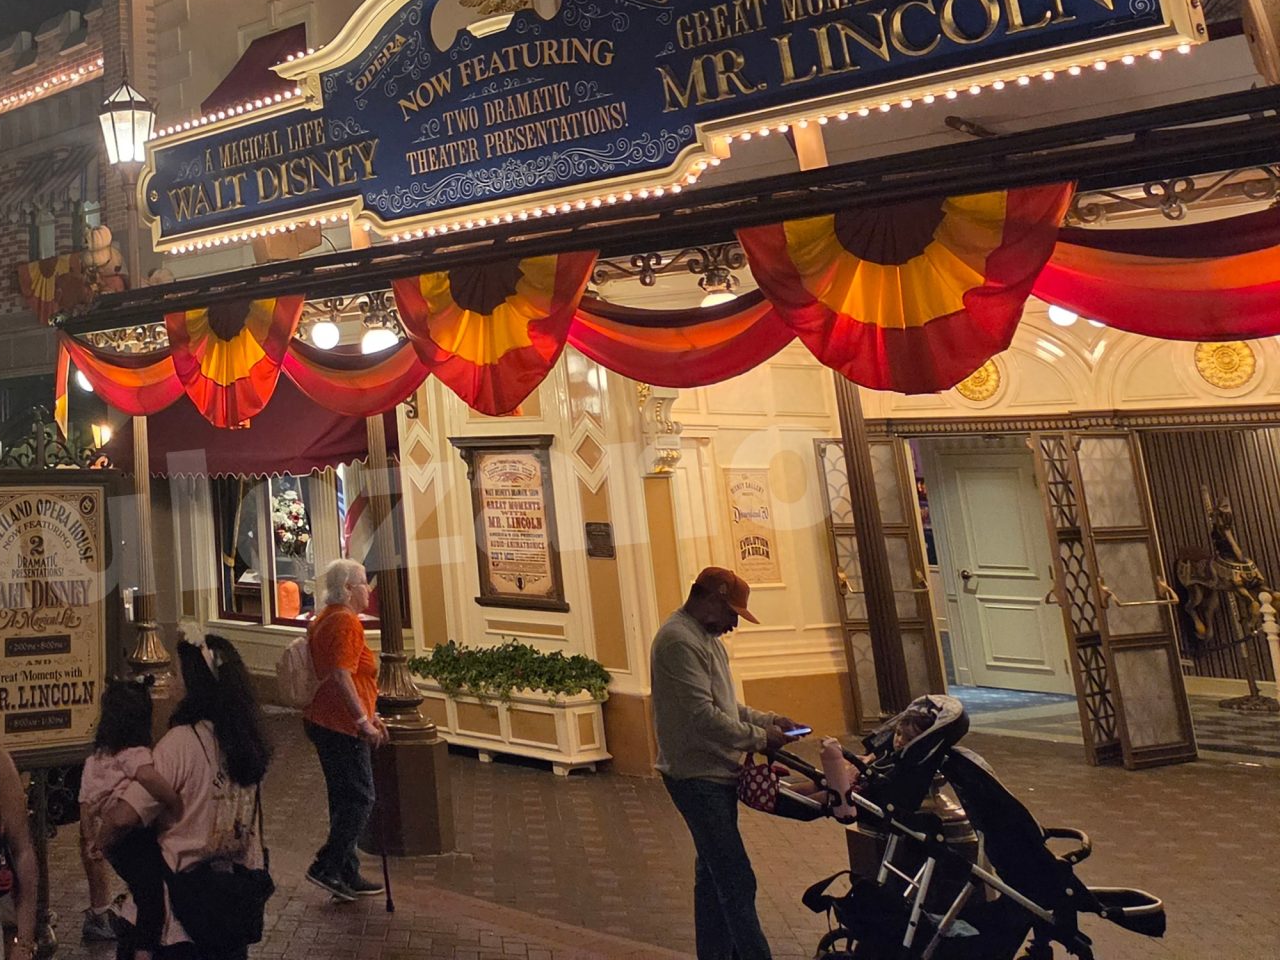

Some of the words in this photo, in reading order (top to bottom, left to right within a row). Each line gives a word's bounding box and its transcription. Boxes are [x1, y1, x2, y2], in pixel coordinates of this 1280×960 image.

[355, 34, 407, 92] OPERA
[398, 68, 453, 121] NOW
[459, 39, 615, 88] FEATURING
[656, 47, 768, 113] MR.
[443, 106, 480, 136] TWO
[485, 82, 572, 128] DRAMATIC
[204, 149, 216, 173] A
[218, 132, 282, 168] MAGICAL
[287, 119, 326, 151] LIFE
[406, 140, 481, 176] THEATER
[485, 101, 629, 162] PRESENTATIONS!
[168, 171, 247, 223] WALT
[257, 140, 380, 203] DISNEY
[486, 500, 506, 510] GREAT
[508, 501, 541, 511] MOMENTS
[3, 526, 22, 552] NOW
[24, 520, 73, 549] FEATURING
[36, 499, 71, 527] OPERA
[68, 520, 94, 564] HOUSE
[488, 516, 505, 528] MR.
[507, 517, 542, 529] LINCOLN
[29, 535, 45, 556] 2
[740, 536, 769, 549] EVOLUTION
[12, 567, 64, 578] PRESENTATIONS!
[18, 552, 58, 568] DRAMATIC
[32, 579, 92, 610] DISNEY
[17, 609, 58, 632] Magical
[59, 607, 82, 628] Life
[20, 669, 62, 682] Moments
[64, 667, 83, 678] with
[18, 681, 95, 709] LINCOLN
